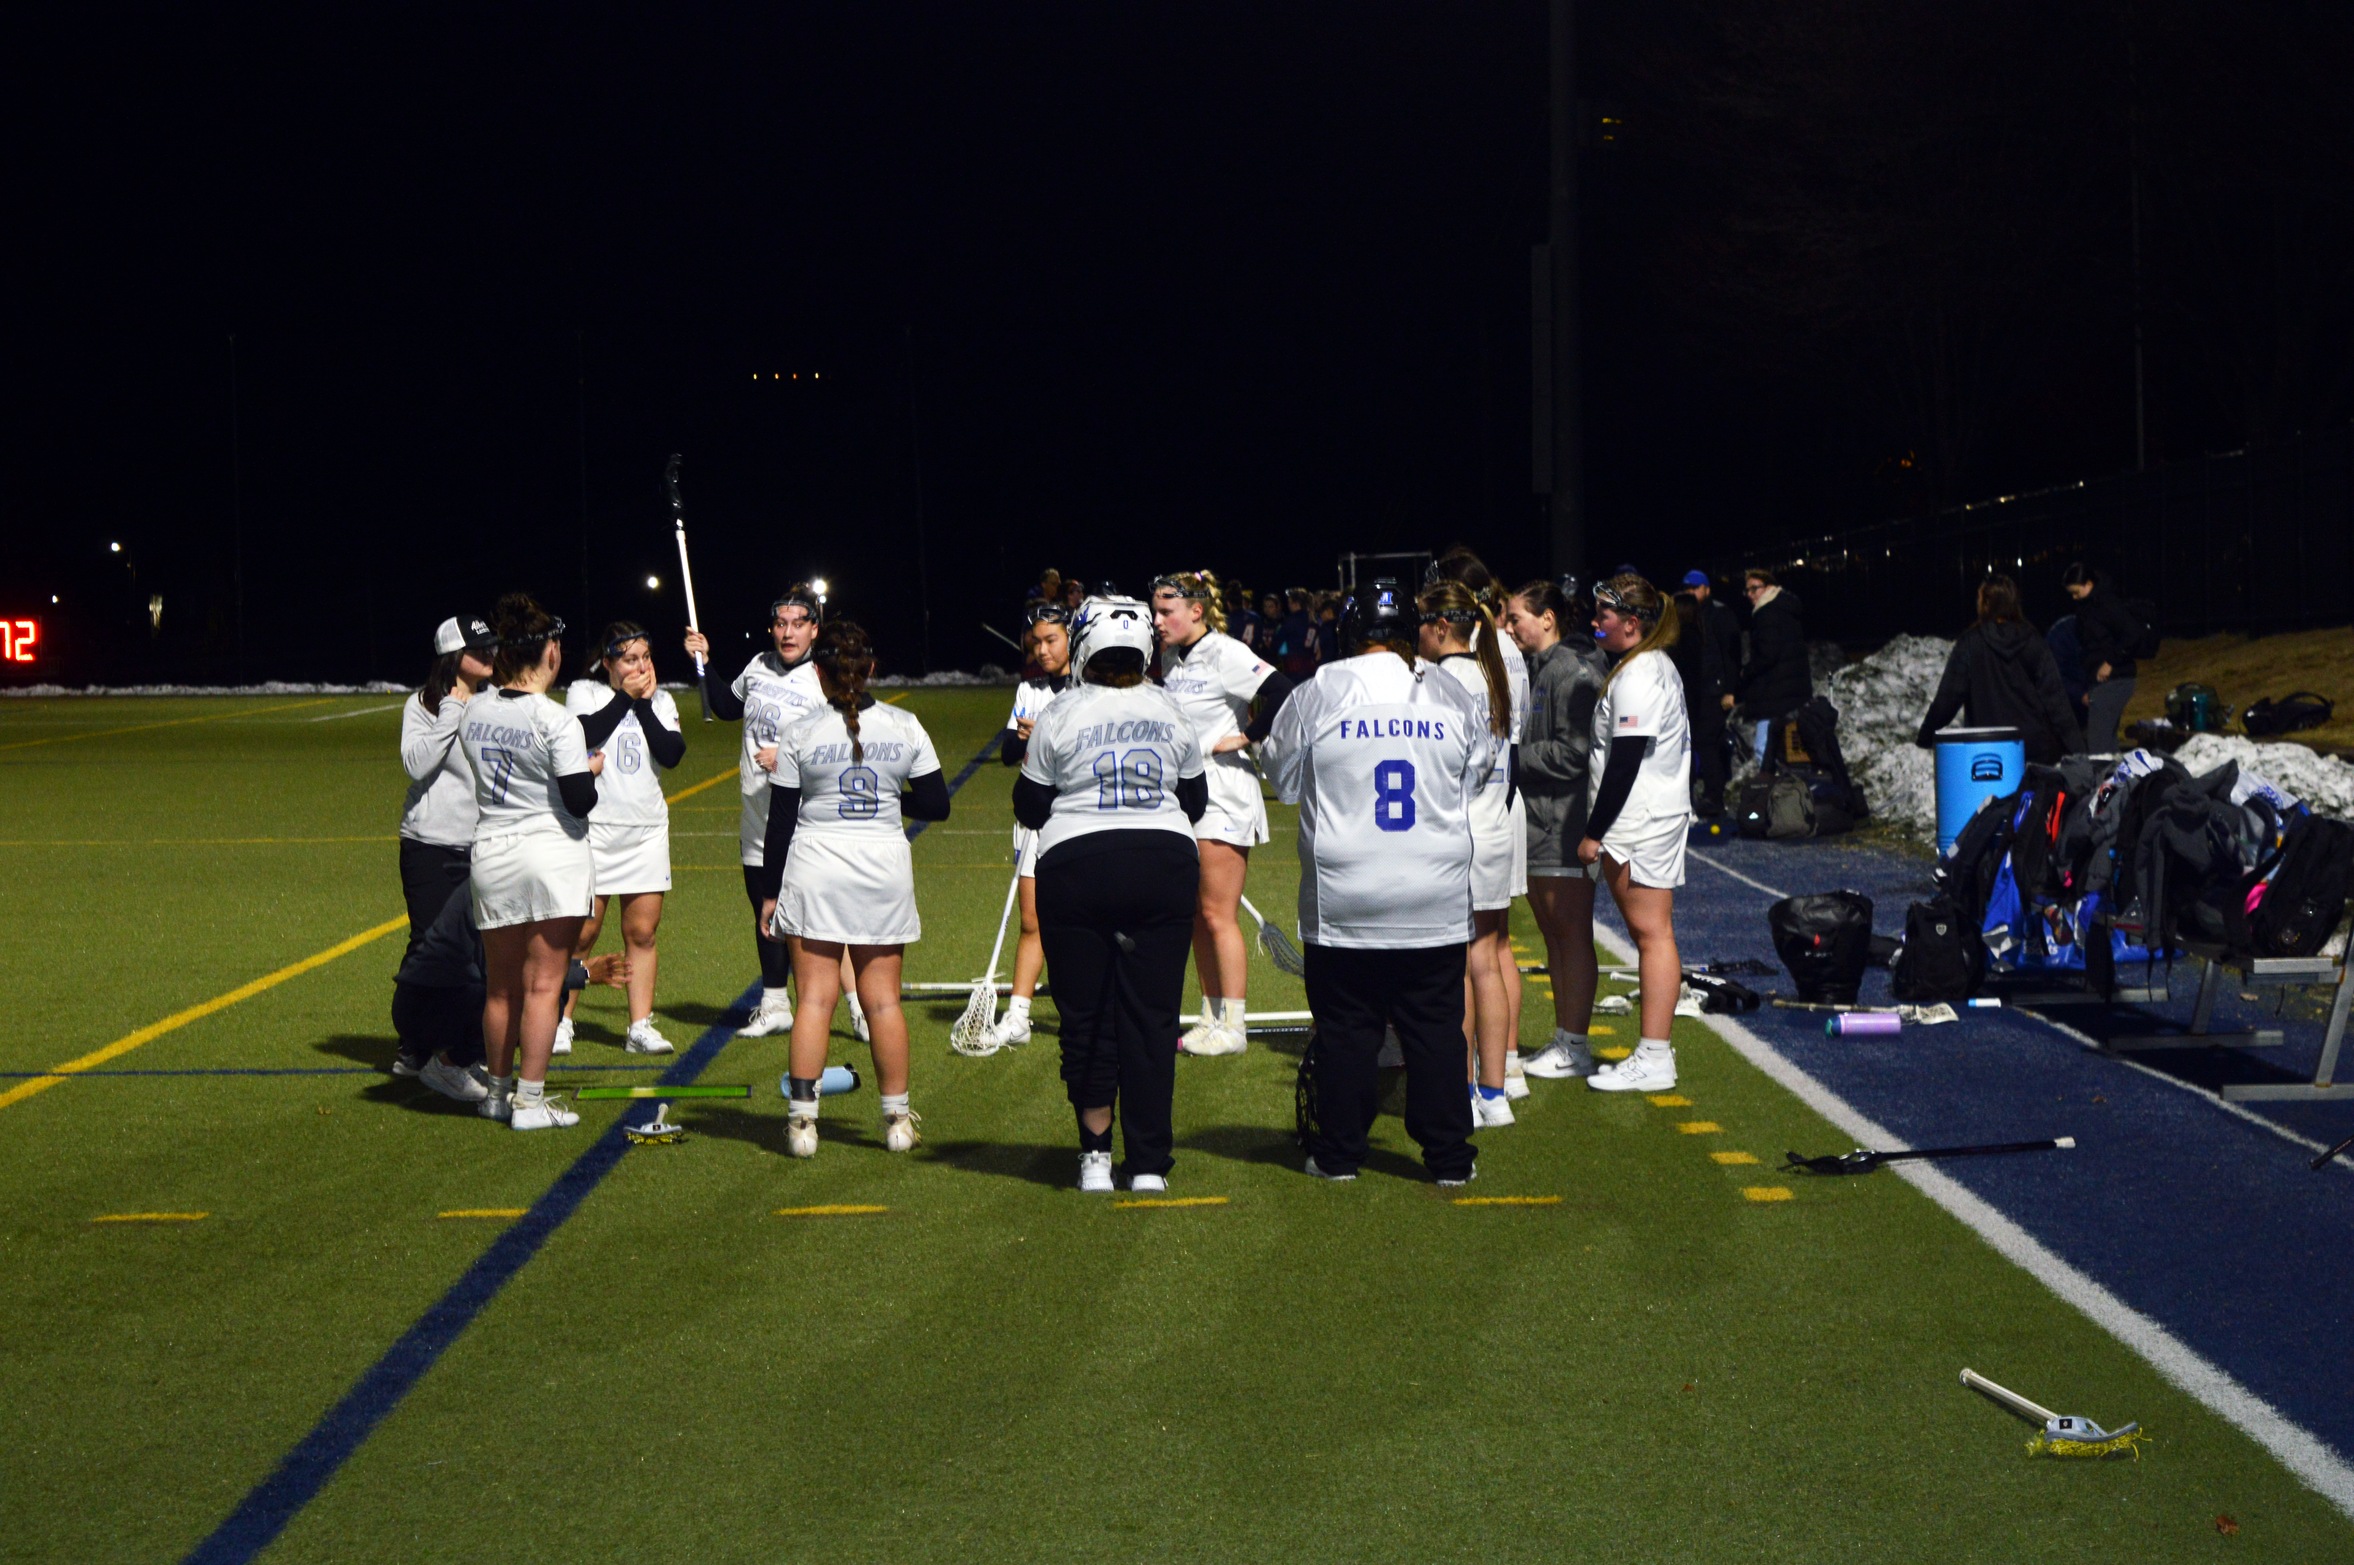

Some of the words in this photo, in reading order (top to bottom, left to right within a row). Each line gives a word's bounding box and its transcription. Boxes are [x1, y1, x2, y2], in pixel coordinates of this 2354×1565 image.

[465, 722, 534, 750] FALCONS
[744, 697, 781, 742] 26
[1075, 720, 1175, 752] FALCONS
[1340, 719, 1444, 740] FALCONS
[616, 732, 641, 775] 6
[810, 742, 904, 766] FALONS
[481, 747, 513, 805] 7
[838, 766, 879, 821] 9
[1092, 748, 1165, 810] 18
[1374, 759, 1416, 833] 8
